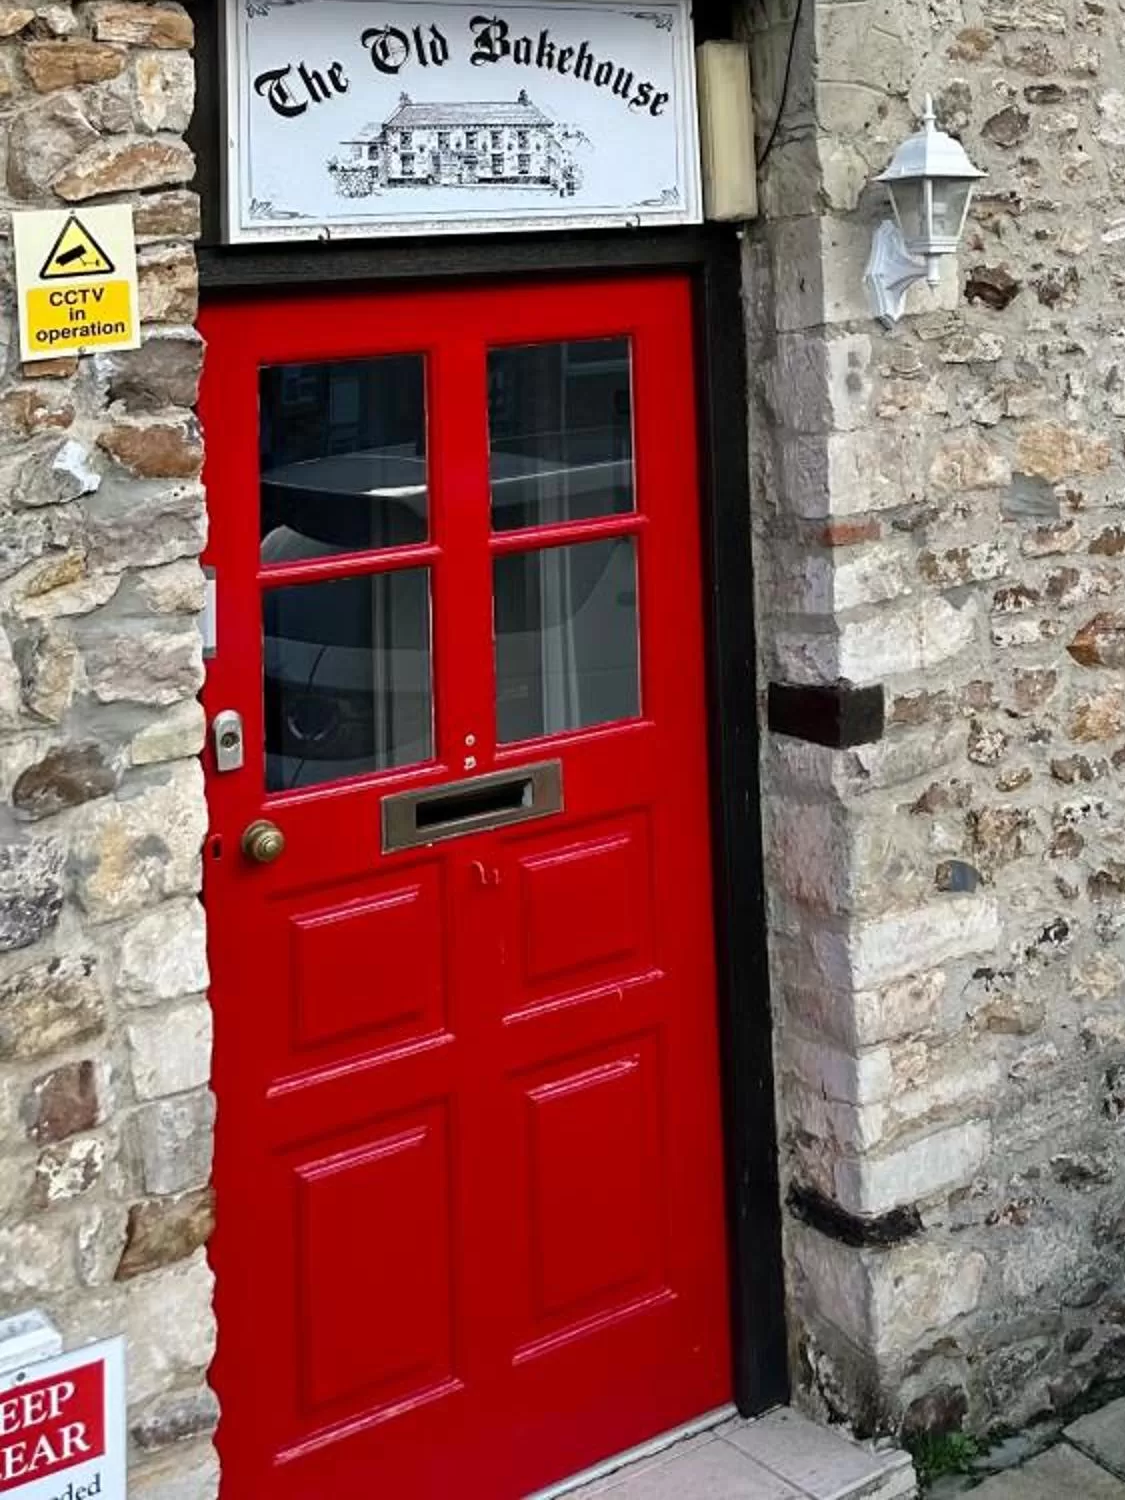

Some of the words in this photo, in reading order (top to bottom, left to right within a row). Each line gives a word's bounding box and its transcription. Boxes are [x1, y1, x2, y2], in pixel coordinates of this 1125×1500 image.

[254, 59, 350, 118] The
[361, 22, 450, 75] Old
[469, 15, 670, 118] Bakehouse
[49, 288, 104, 307] CCTV
[69, 308, 86, 321] in
[36, 321, 126, 344] operation
[0, 1421, 91, 1481] EAR
